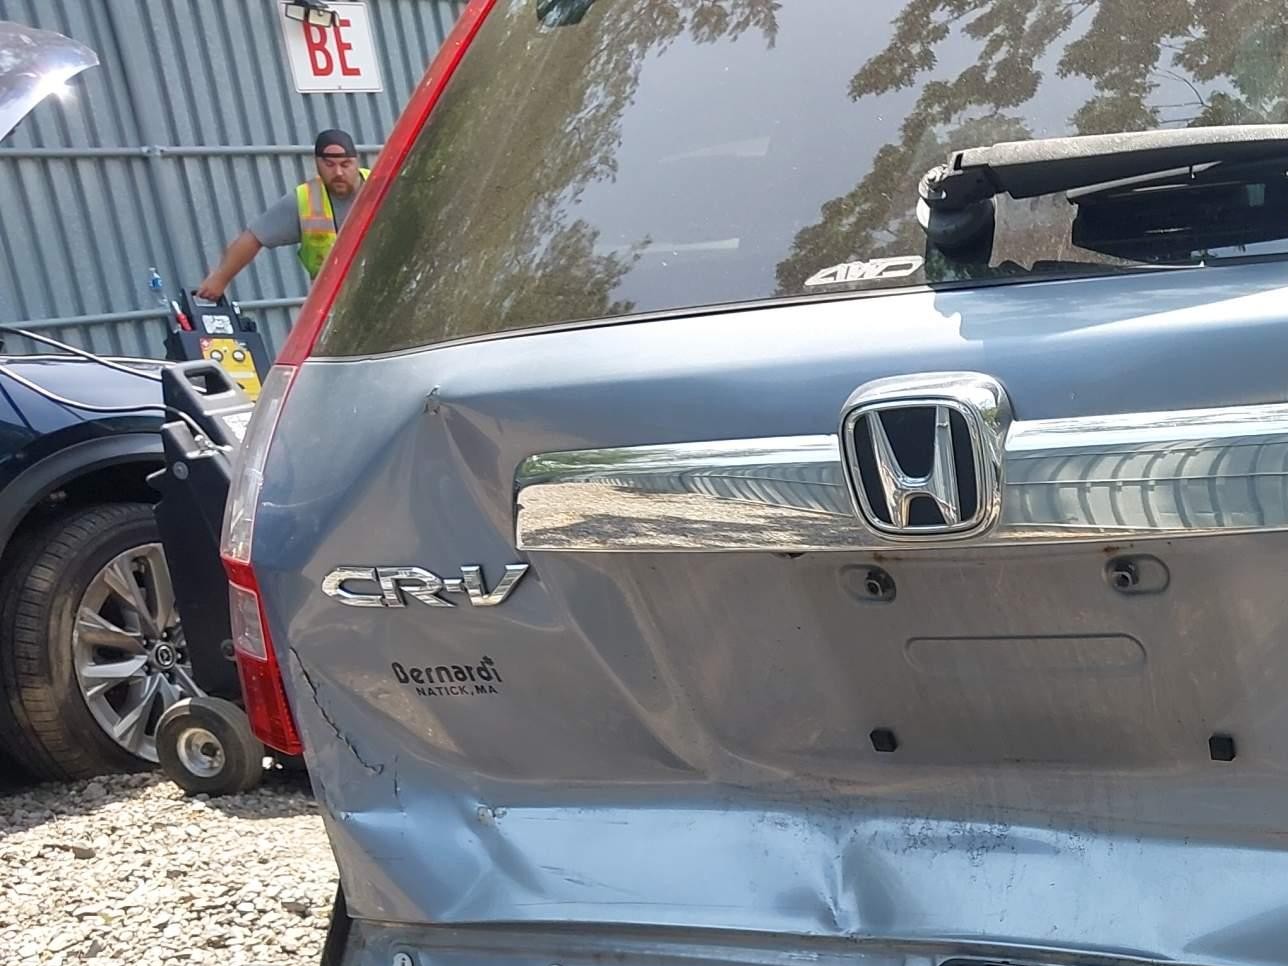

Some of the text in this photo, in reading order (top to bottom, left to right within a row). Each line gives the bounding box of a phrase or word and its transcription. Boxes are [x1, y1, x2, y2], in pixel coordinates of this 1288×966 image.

[303, 19, 362, 76] BE
[321, 563, 530, 608] CR-V
[392, 656, 502, 684] Bernardi
